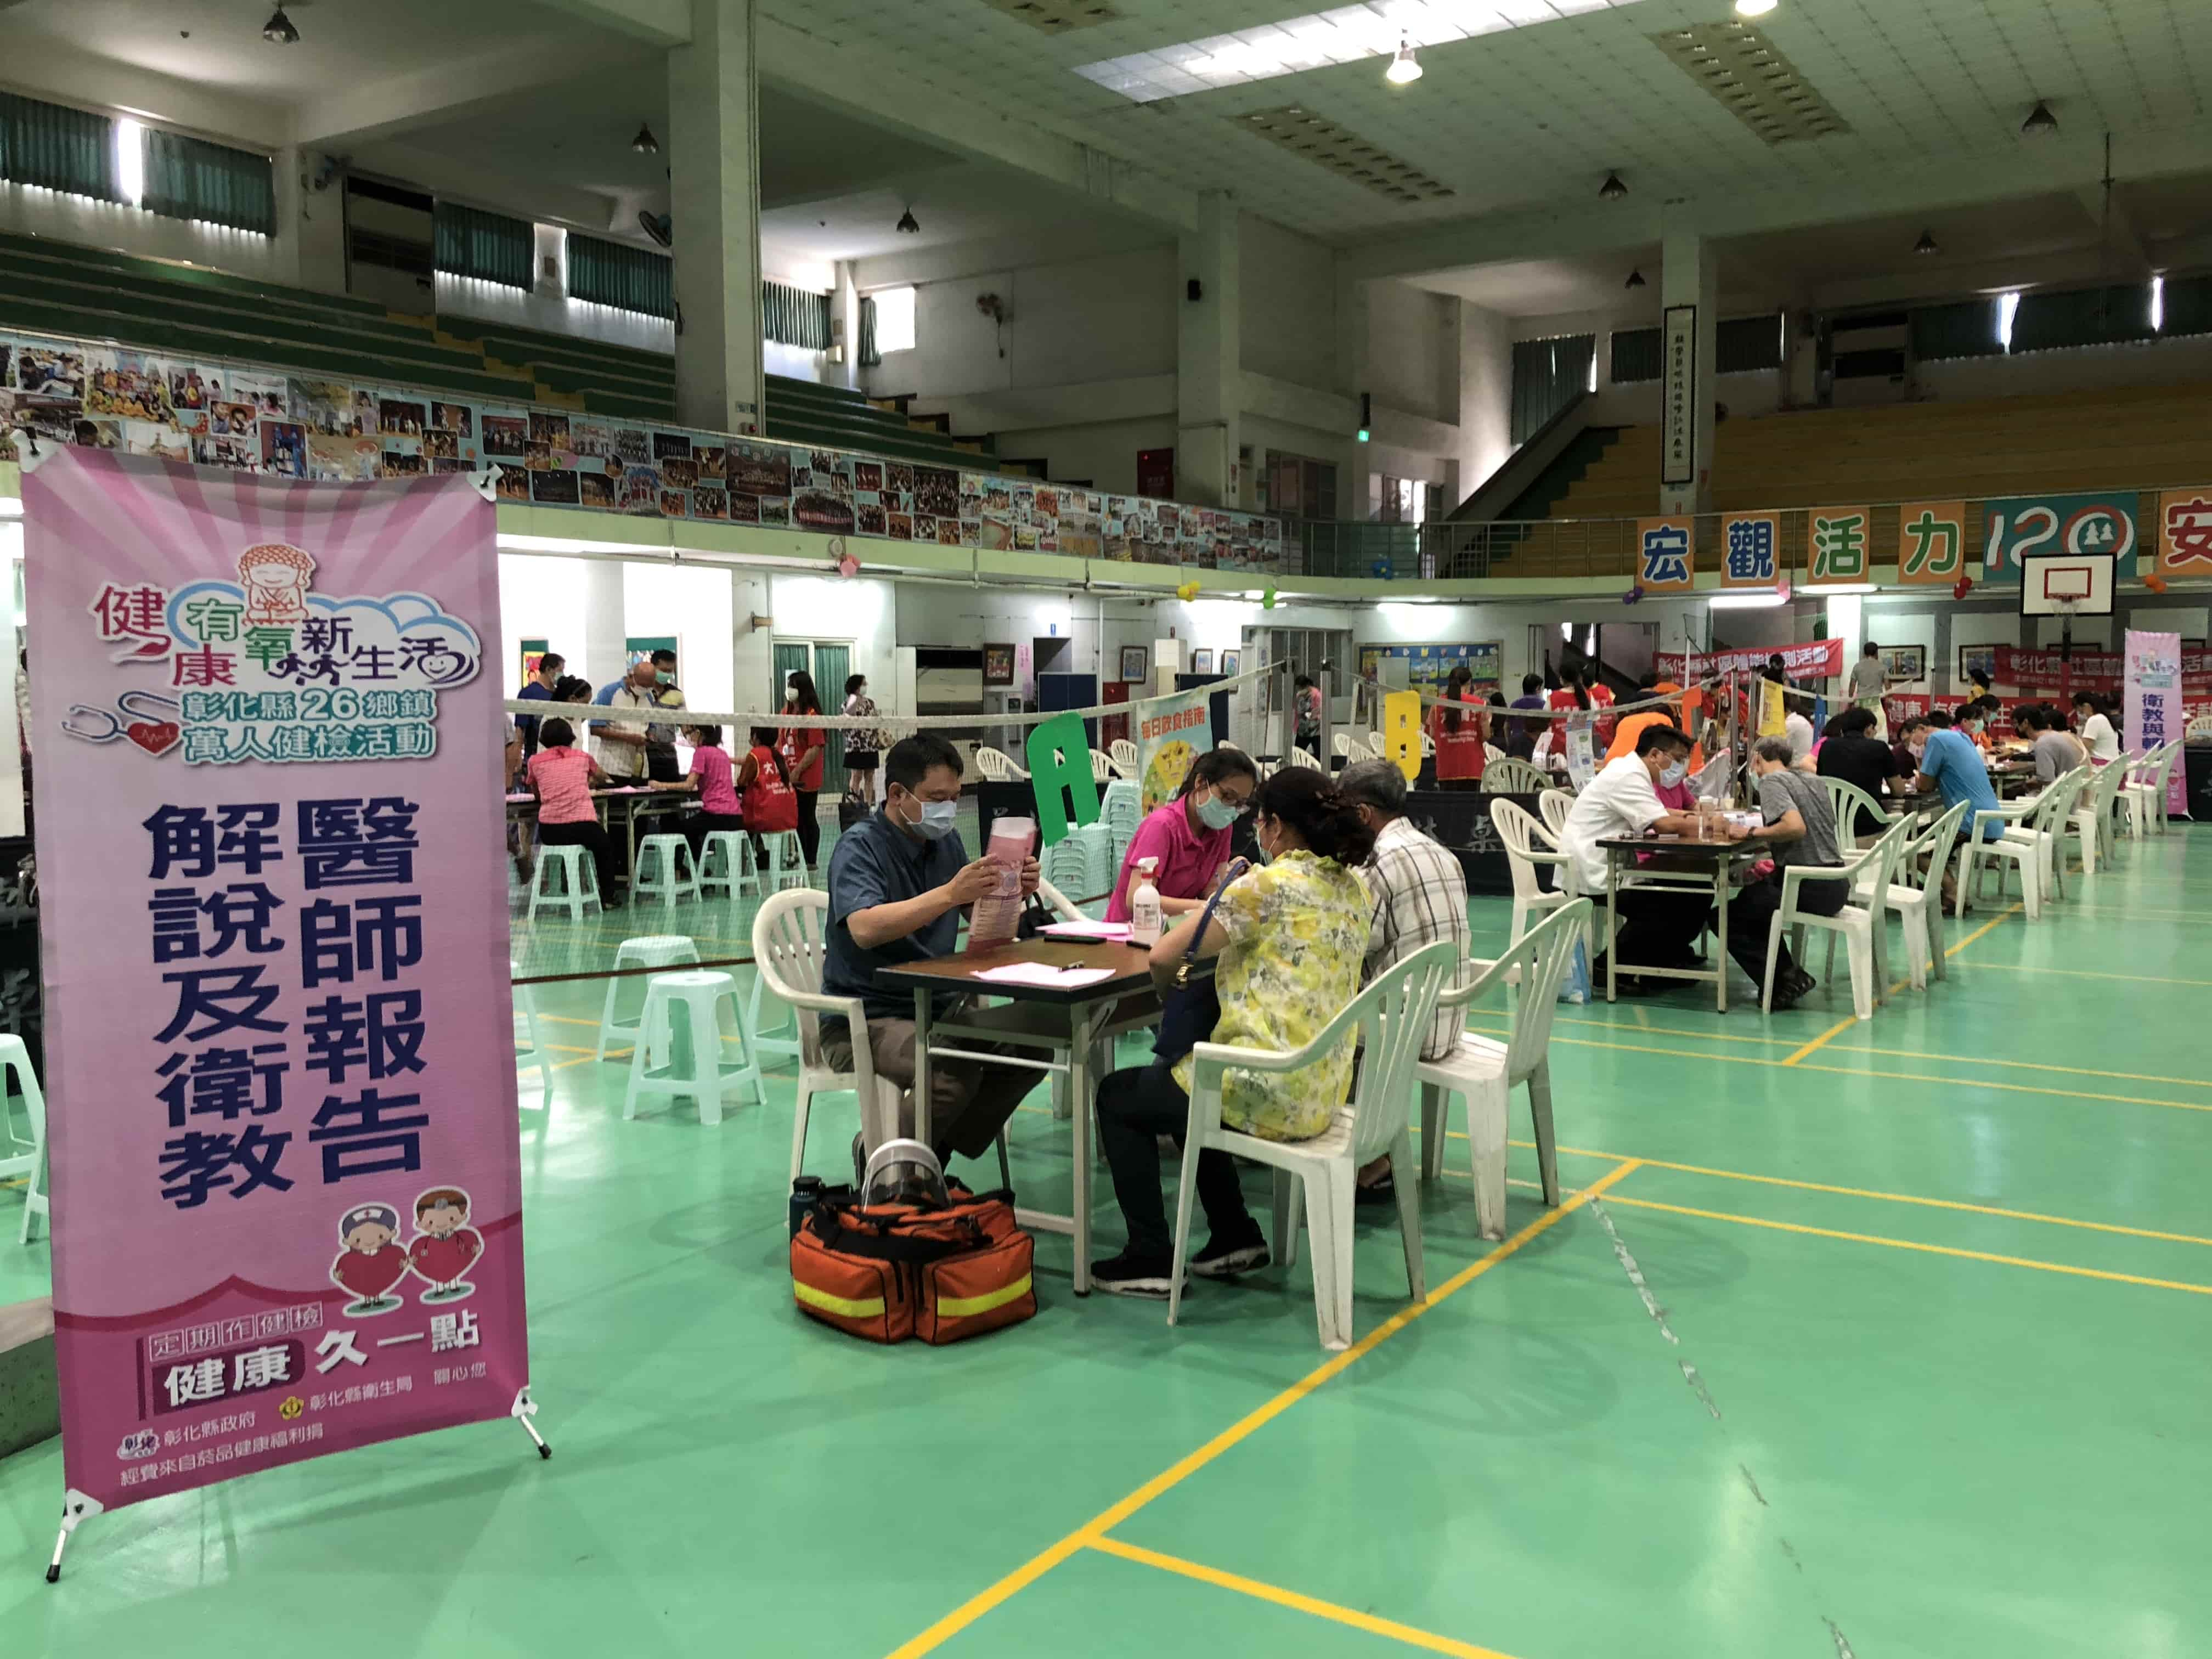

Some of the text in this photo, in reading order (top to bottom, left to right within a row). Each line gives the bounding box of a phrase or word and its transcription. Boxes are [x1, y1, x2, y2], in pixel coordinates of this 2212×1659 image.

[2165, 496, 2212, 567] 安
[183, 690, 435, 721] 彰化縣26鄉鎮
[1141, 706, 1205, 741] 每日飲食指南
[184, 725, 436, 761] 萬人健檢活動
[1026, 712, 1101, 847] A
[143, 802, 295, 1209] 解說及衛教
[297, 797, 429, 1185] 醫師報告
[150, 1304, 321, 1361] 定期作健檢
[164, 1310, 479, 1406] 健康 久一點
[309, 1376, 413, 1411] 彰化縣衛生局
[163, 1411, 256, 1446] 彰化縣政府
